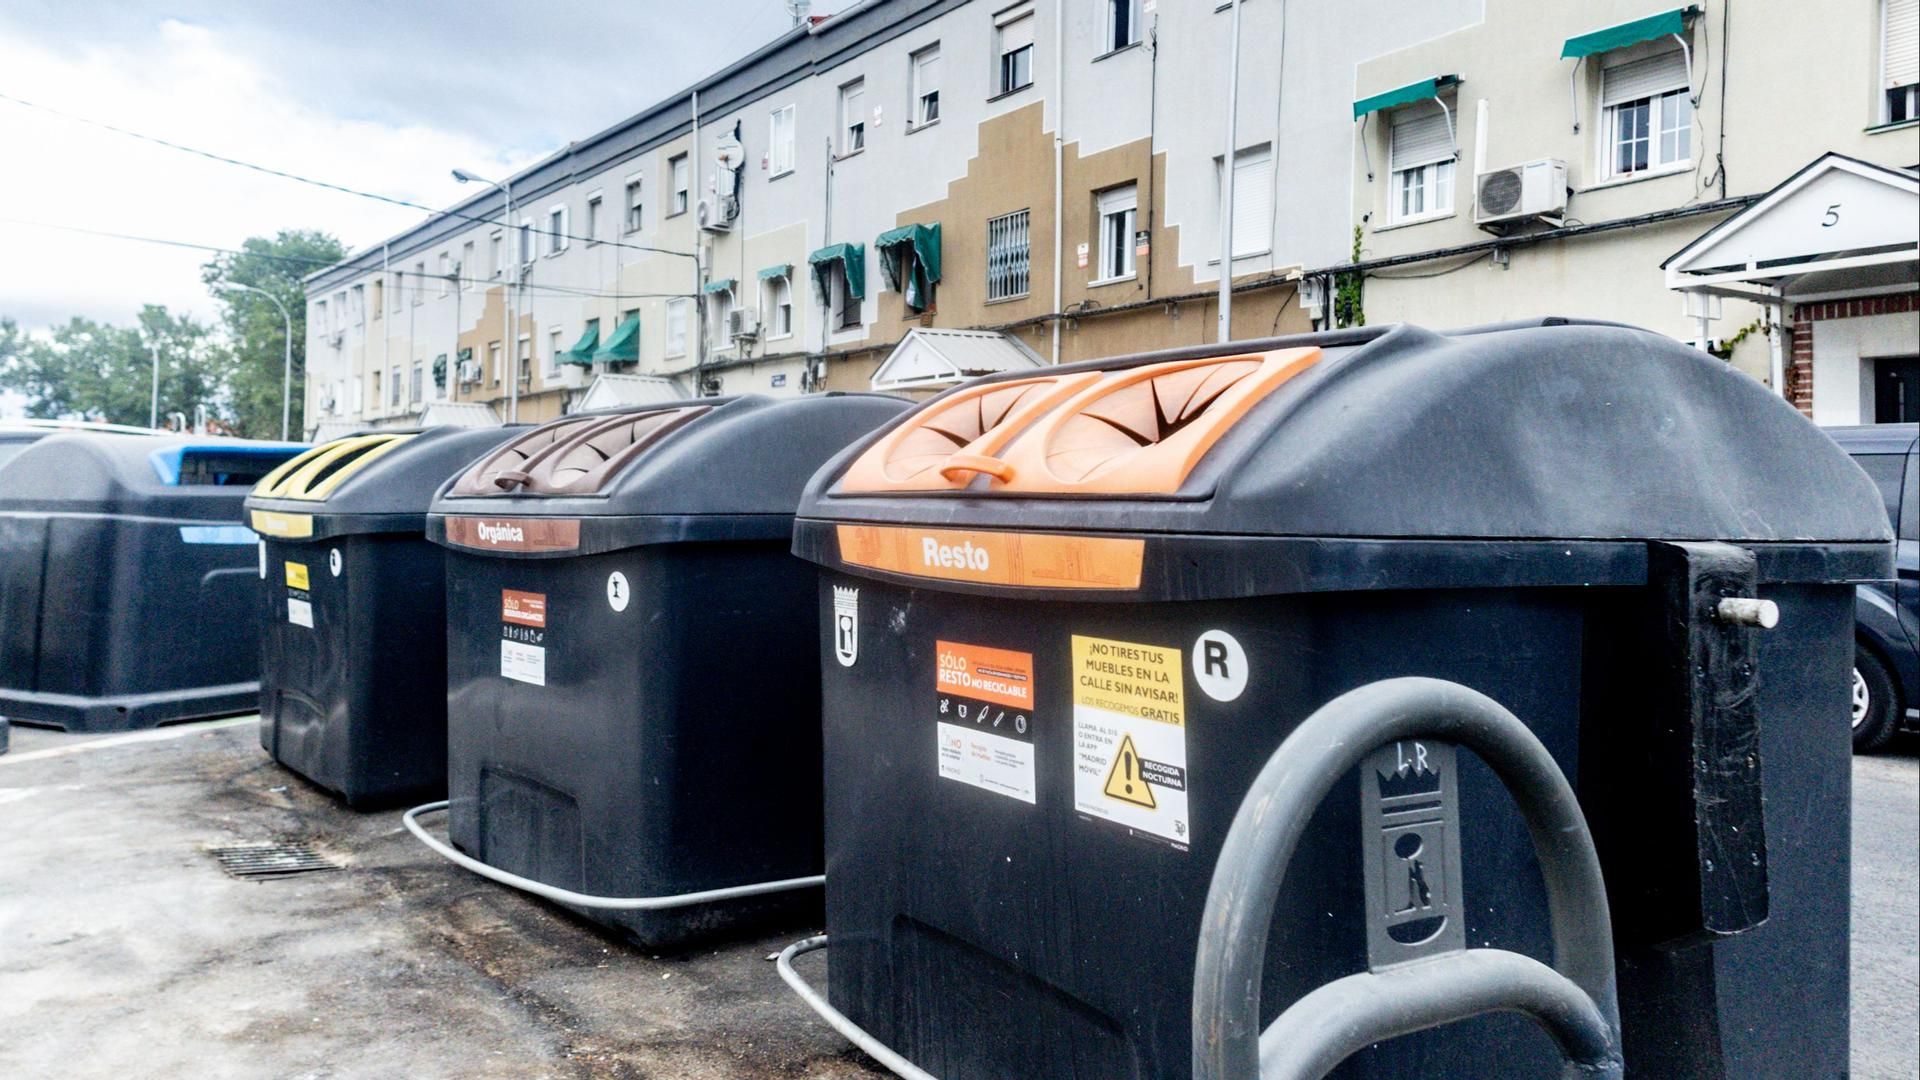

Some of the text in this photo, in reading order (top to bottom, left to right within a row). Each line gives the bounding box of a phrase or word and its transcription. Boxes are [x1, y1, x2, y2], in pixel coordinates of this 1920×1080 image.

[1822, 203, 1841, 227] 5
[478, 521, 524, 545] Orgánica
[922, 537, 989, 571] Resto
[940, 650, 967, 671] SÓLO
[1089, 643, 1164, 665] ¡NO TIRES TUS
[1204, 639, 1230, 679] R
[939, 669, 971, 687] RESTO
[971, 678, 983, 689] NO
[983, 680, 1027, 698] RECICLABLE
[1086, 659, 1170, 684] MUEBLES EN LA
[1080, 675, 1179, 704] CALLE SIN AVISAR!
[1081, 695, 1180, 724] LOS RECOGEMOS GRATIS
[1142, 771, 1183, 788] NOCTURNA
[1144, 761, 1180, 776] RECOGIDA
